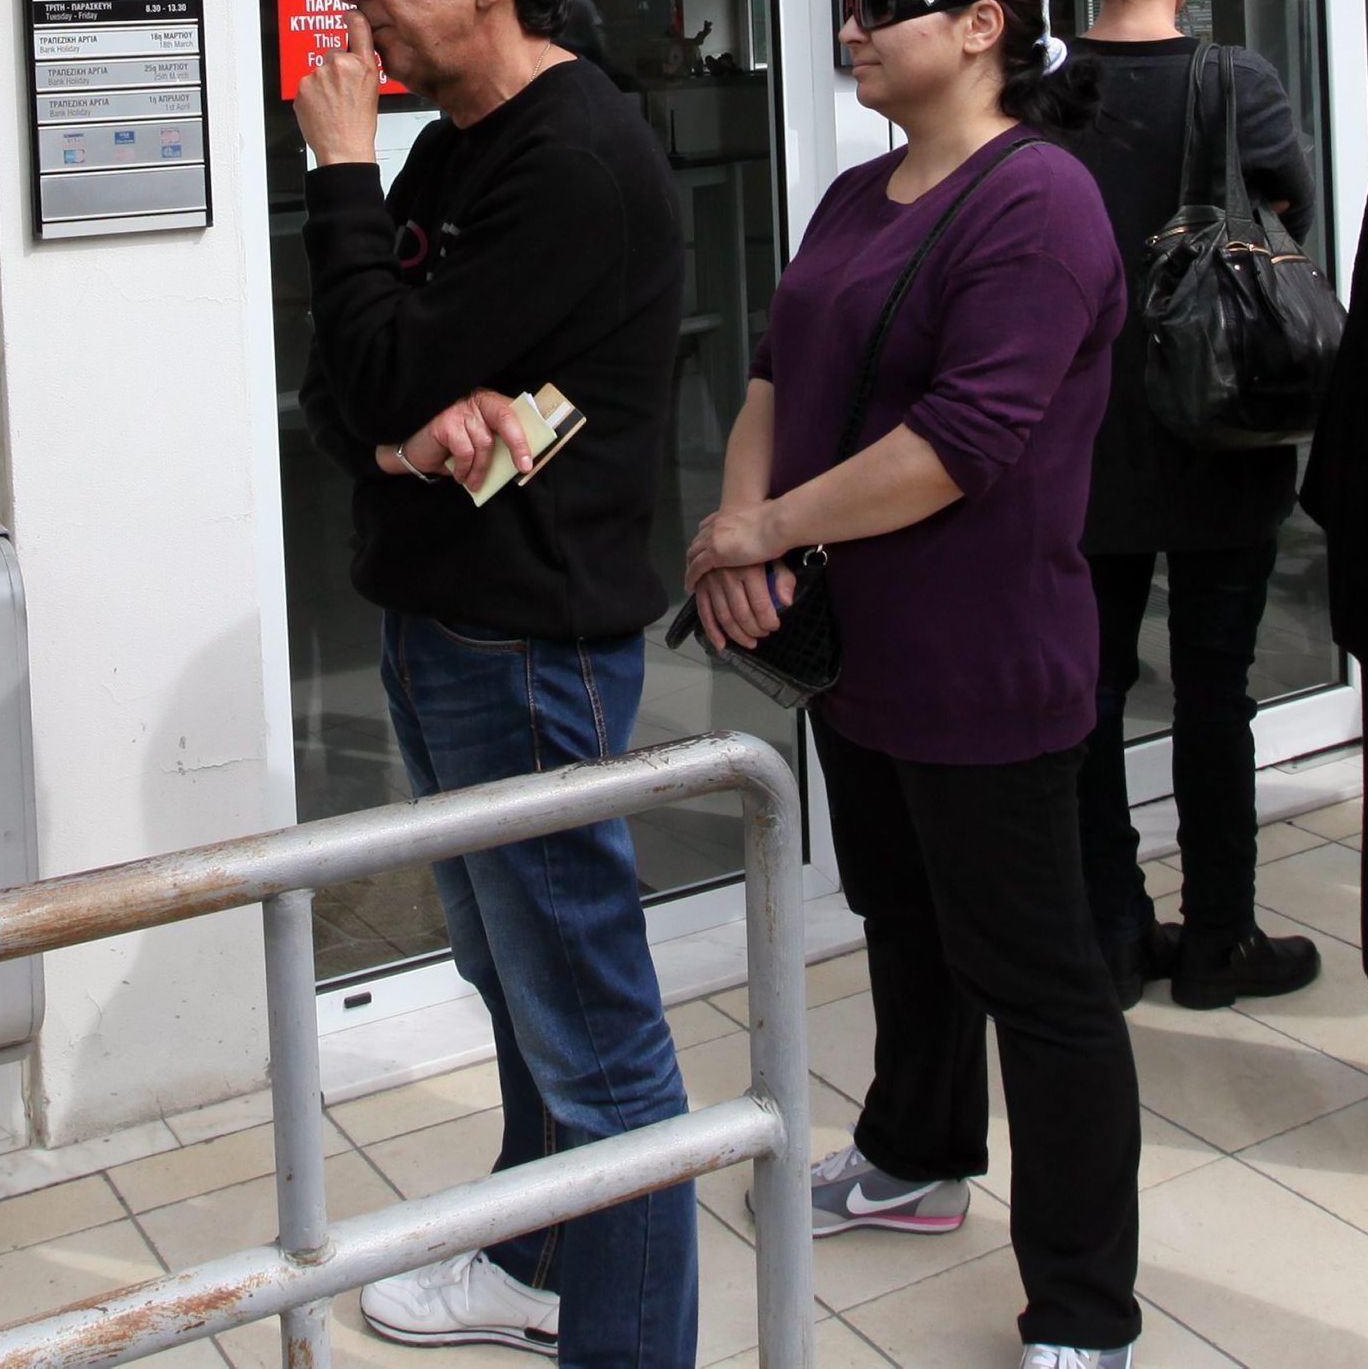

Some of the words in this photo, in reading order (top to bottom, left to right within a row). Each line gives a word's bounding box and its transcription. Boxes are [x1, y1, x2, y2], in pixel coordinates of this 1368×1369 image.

[45, 3, 66, 12] ΤΡΙΤΗ
[71, 2, 112, 11] ΠΑΡΑΣΚΕΥΗ
[145, 4, 162, 13] 8.30
[167, 3, 187, 12] 13.30
[46, 12, 72, 21] Tuesday
[78, 11, 98, 21] Friday
[290, 15, 348, 31] ΚΤΥΠΗΣ
[39, 36, 76, 45] ΤΡΑΠΕΖΙΚΗ
[78, 35, 97, 44] ΑΡΓΙΑ
[163, 32, 193, 40] ΜΑΡΤΙΟΥ
[314, 33, 341, 48] This
[39, 45, 56, 54] Bank
[57, 44, 80, 54] Holiday
[47, 68, 87, 77] ΤΡΑΠΕΖΙΚΗ
[88, 67, 108, 75] ΑΡΓΙΑ
[158, 63, 188, 72] ΜΑΡΤΙΟΥ
[48, 77, 64, 86] Bank
[65, 77, 90, 87] Holiday
[49, 100, 88, 109] ΤΡΑΠΕΖΙΚΗ
[89, 98, 110, 107] ΑΡΓΙΑ
[49, 109, 66, 118] Bank
[67, 108, 91, 118] Holiday
